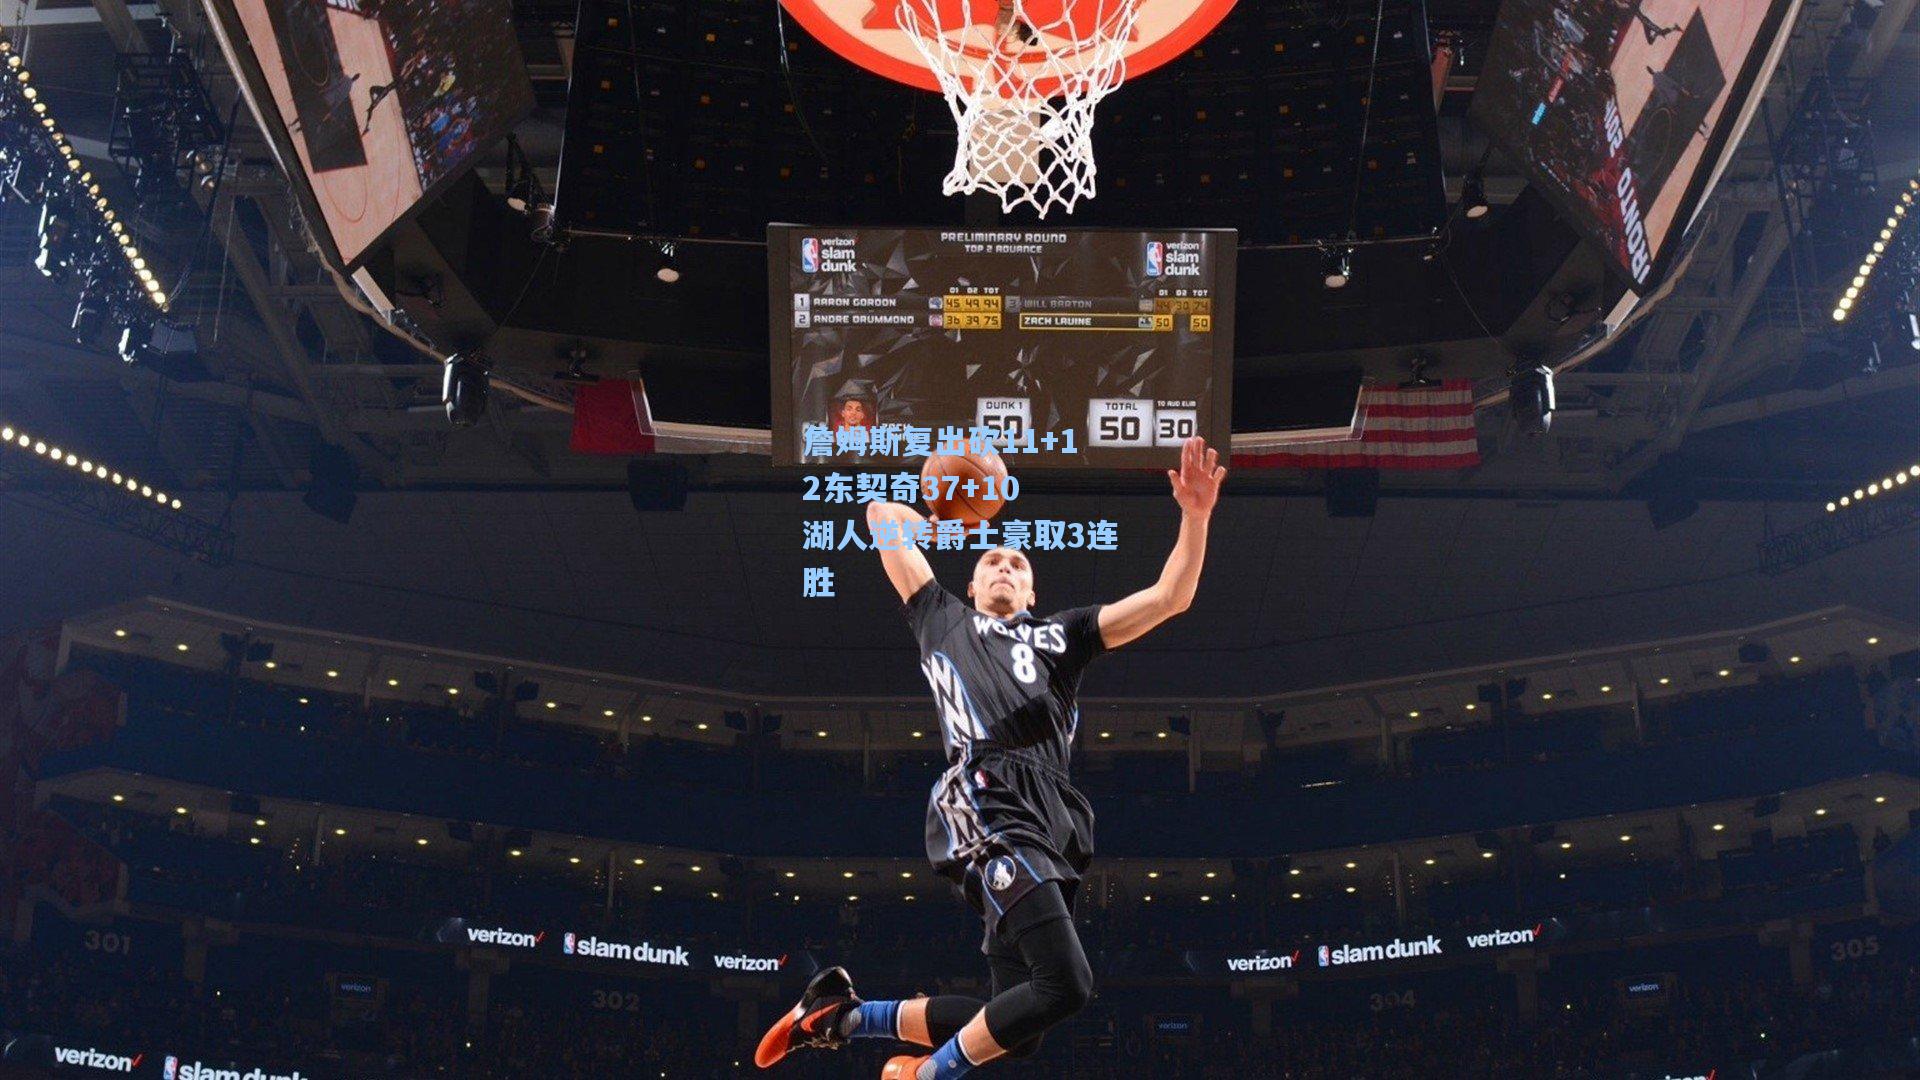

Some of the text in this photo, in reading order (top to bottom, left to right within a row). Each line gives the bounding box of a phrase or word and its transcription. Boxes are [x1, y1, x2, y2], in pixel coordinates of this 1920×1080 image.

[821, 237, 855, 246] verizon
[940, 232, 1067, 243] PRELIMINARY ROUND
[965, 244, 1042, 254] TOP 2 ADVANCE
[1166, 240, 1200, 250] verizon
[821, 246, 855, 260] slam
[1166, 250, 1199, 263] slam
[821, 259, 857, 272] dunk
[1165, 263, 1200, 276] dunk
[813, 298, 850, 307] AARON
[852, 298, 897, 307] GORDON
[946, 299, 960, 308] 45
[965, 299, 980, 308] 49
[984, 299, 999, 308] 94
[1024, 299, 1048, 309] WILL
[1050, 300, 1092, 309] BARTON
[799, 315, 806, 324] 2
[813, 315, 850, 324] ANDRE
[852, 315, 915, 324] DRUMMOND
[965, 315, 980, 325] 39
[984, 315, 999, 325] 75
[1024, 317, 1208, 327] ZACH LAVINE 50 50
[985, 401, 1023, 410] DUNK 1
[1105, 402, 1138, 411] TOTAL
[1100, 416, 1140, 441] 50
[1159, 419, 1193, 438] 30
[1011, 642, 1037, 683] 8
[84, 929, 131, 954] 301
[467, 927, 536, 948] verizon
[1466, 928, 1534, 948] verizon
[577, 936, 689, 966] slam dunk
[1331, 935, 1442, 966] slam dunk
[1830, 936, 1879, 961] 305
[713, 954, 779, 971] verizon
[1227, 953, 1292, 971] verizon
[340, 982, 372, 993] verizon
[1628, 981, 1659, 992] verizon
[592, 989, 639, 1011] 302
[54, 1047, 132, 1072] verizon
[178, 1061, 240, 1080] slam
